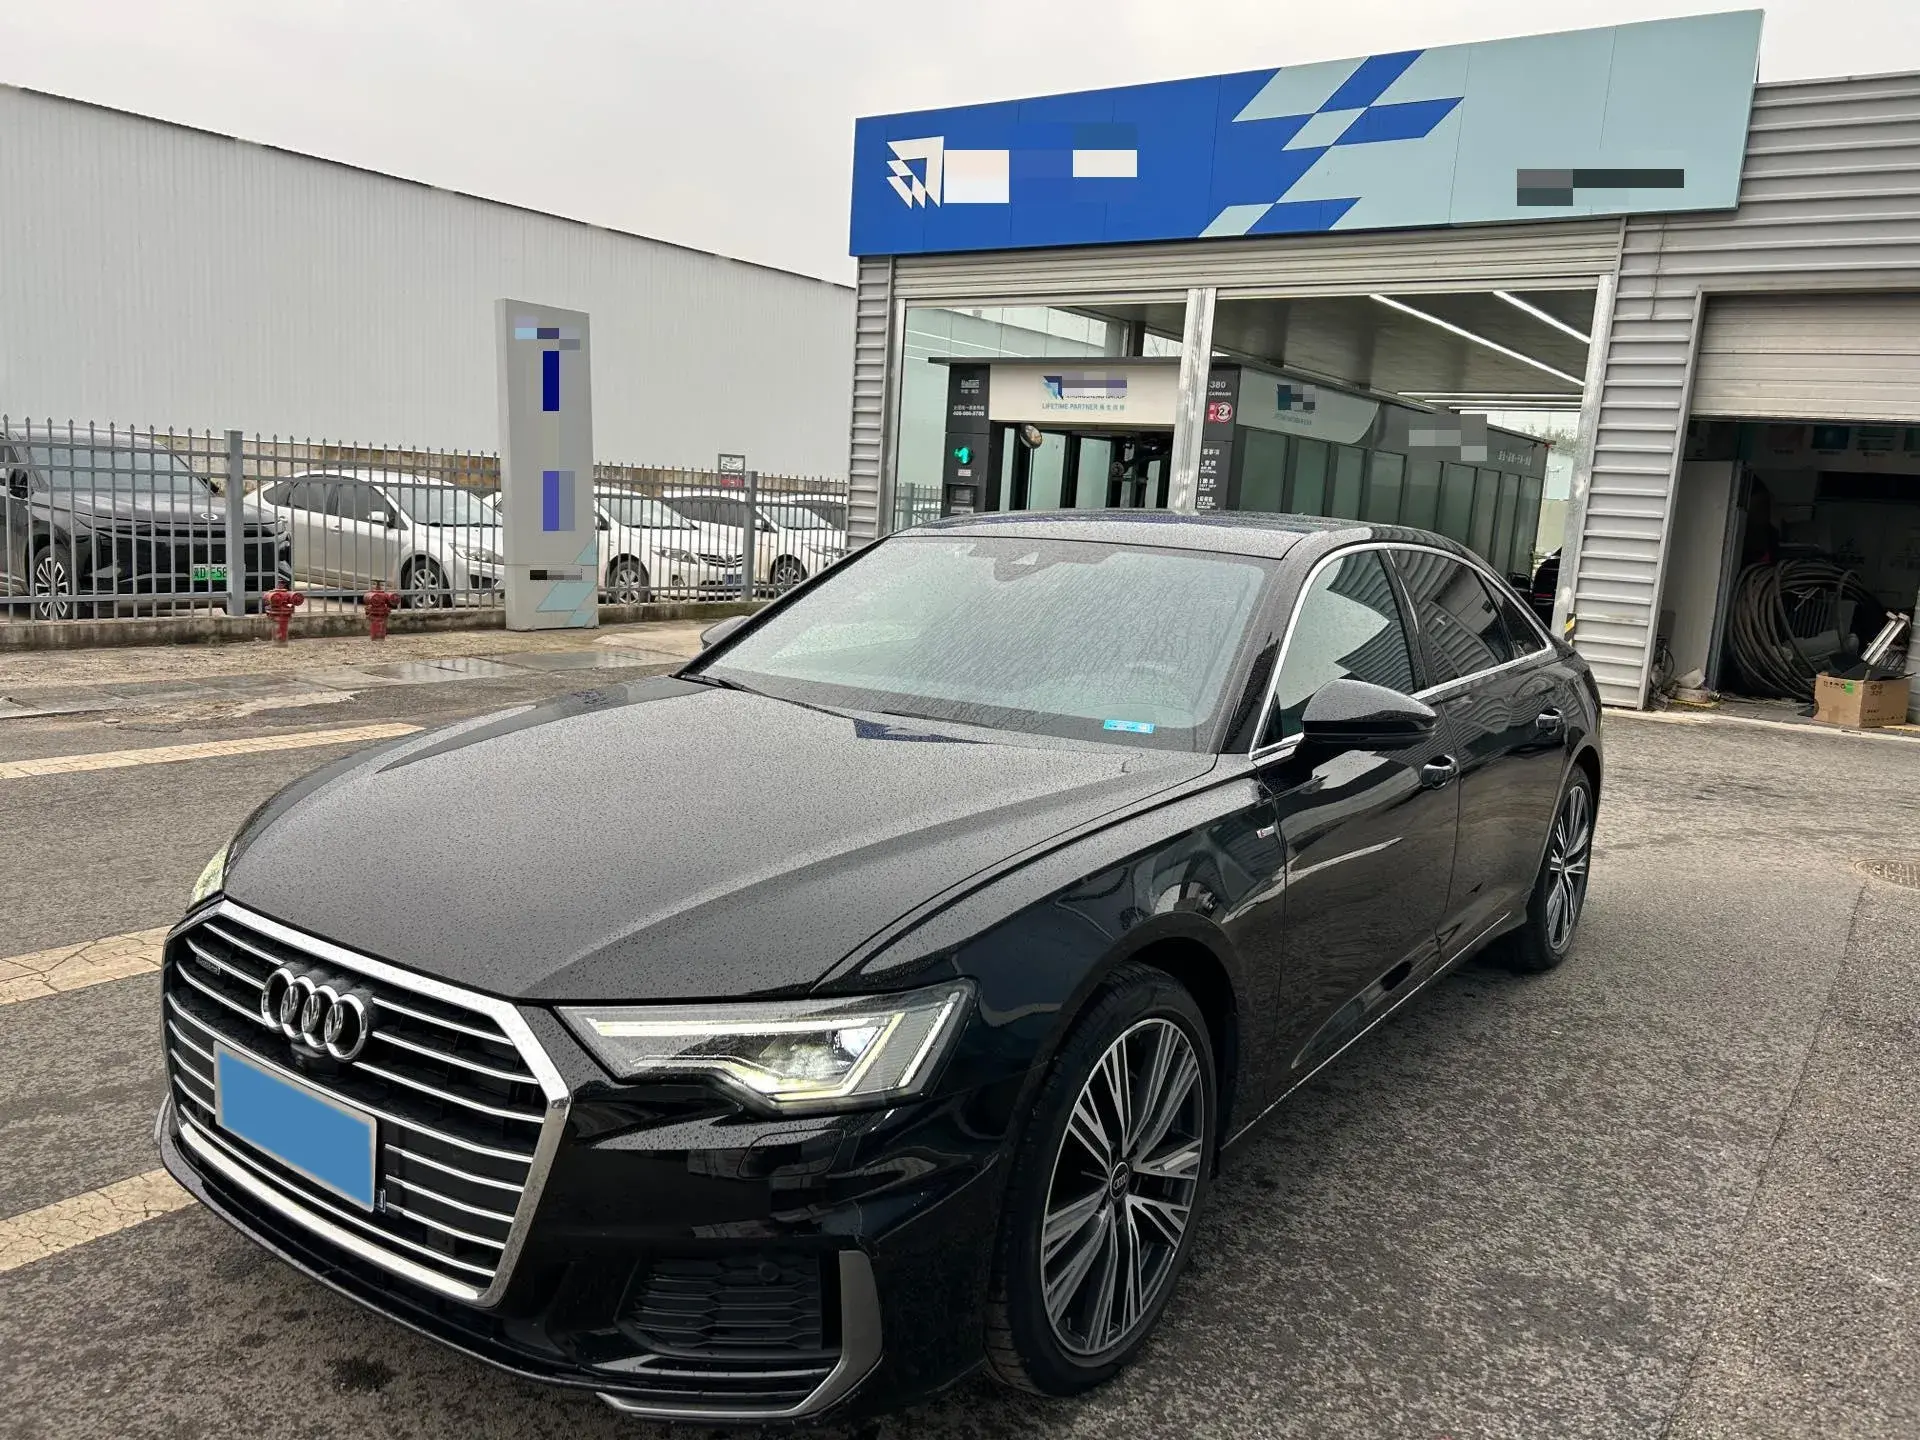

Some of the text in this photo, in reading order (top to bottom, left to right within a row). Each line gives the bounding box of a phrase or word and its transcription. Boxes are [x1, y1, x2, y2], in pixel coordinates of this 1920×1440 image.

[1208, 380, 1226, 389] 380
[1041, 402, 1069, 410] LIFETIME
[1070, 403, 1098, 411] PARTNER
